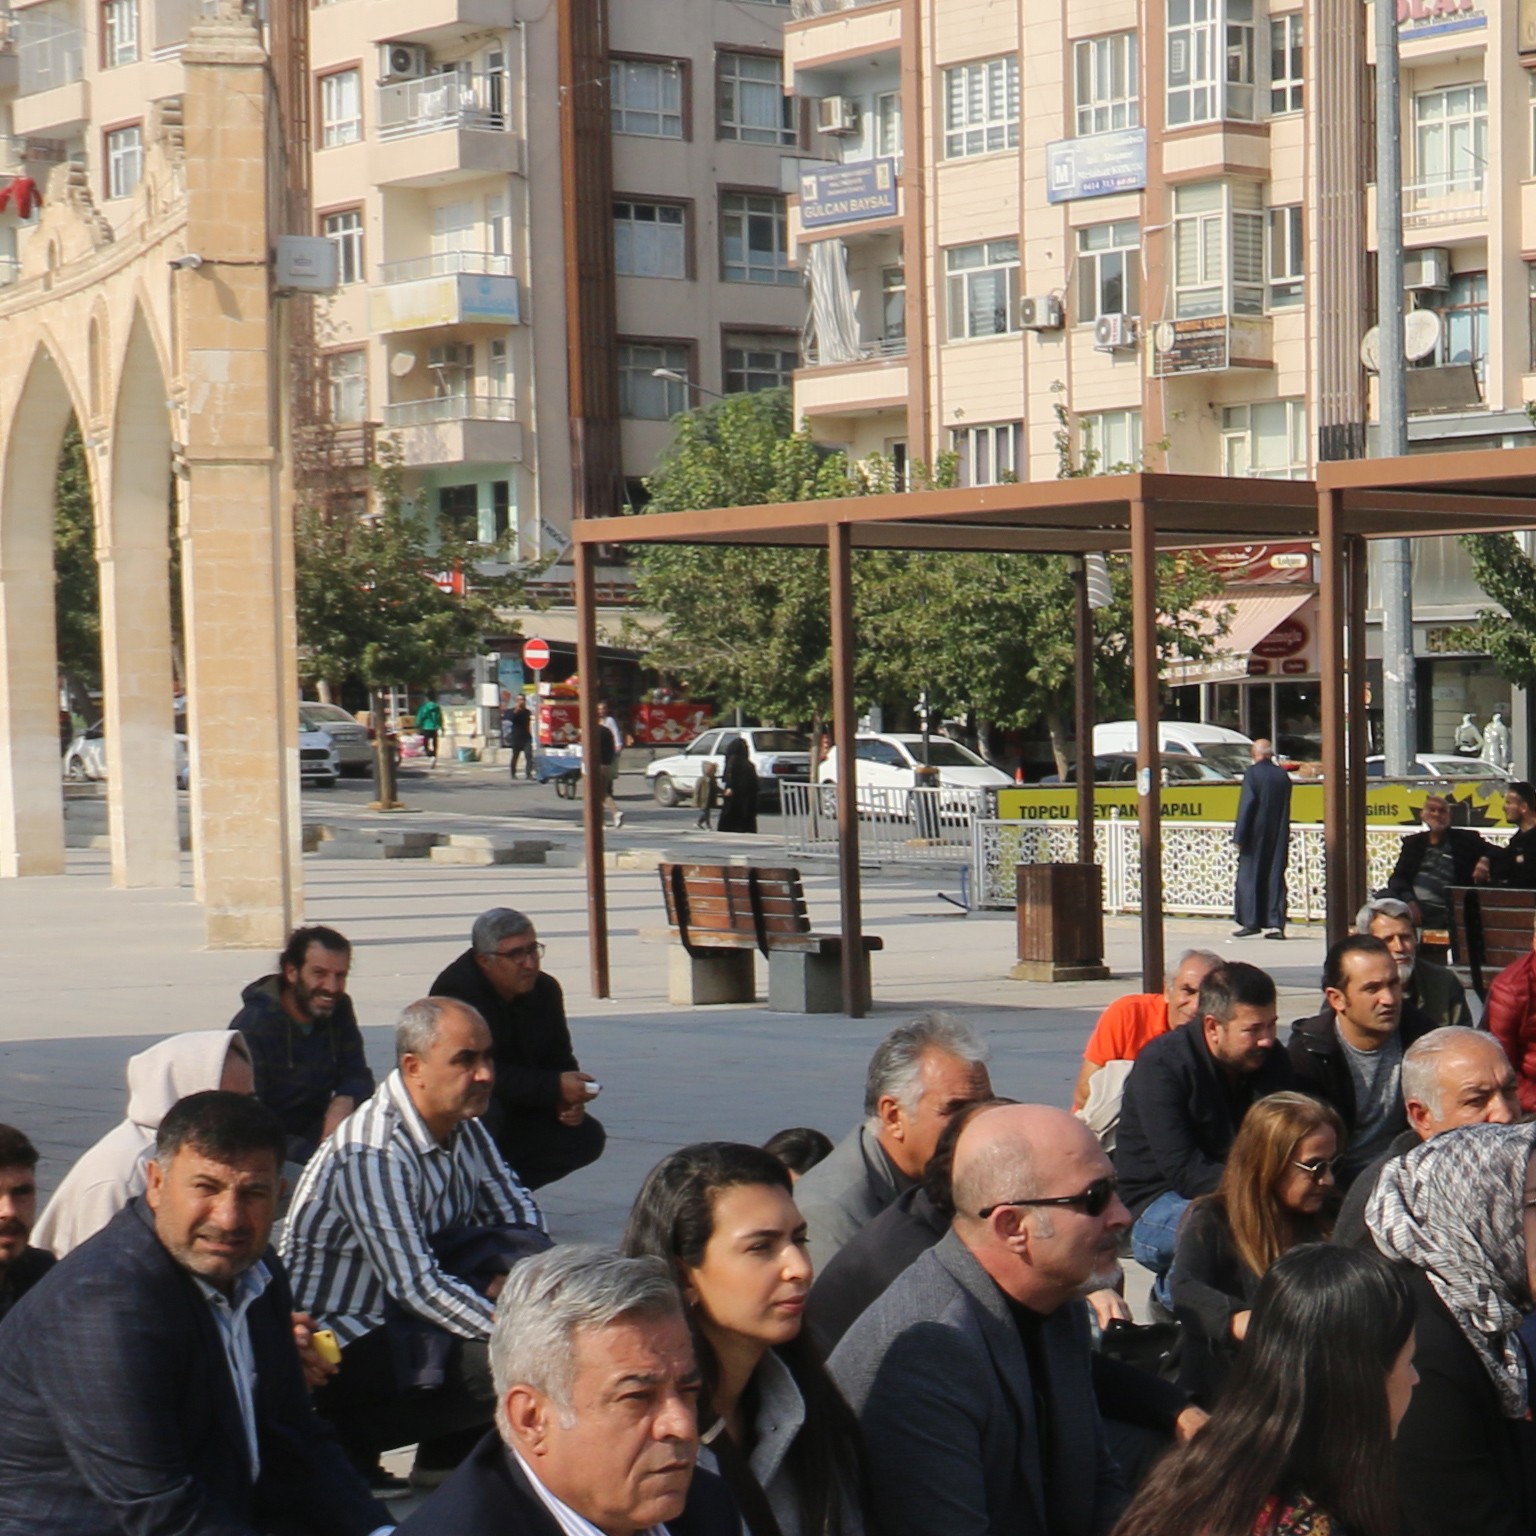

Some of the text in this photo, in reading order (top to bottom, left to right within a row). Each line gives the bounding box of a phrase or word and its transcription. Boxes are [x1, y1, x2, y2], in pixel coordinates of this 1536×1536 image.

[804, 194, 893, 219] GÜLCAN BAYSAL
[1159, 802, 1203, 817] APALI
